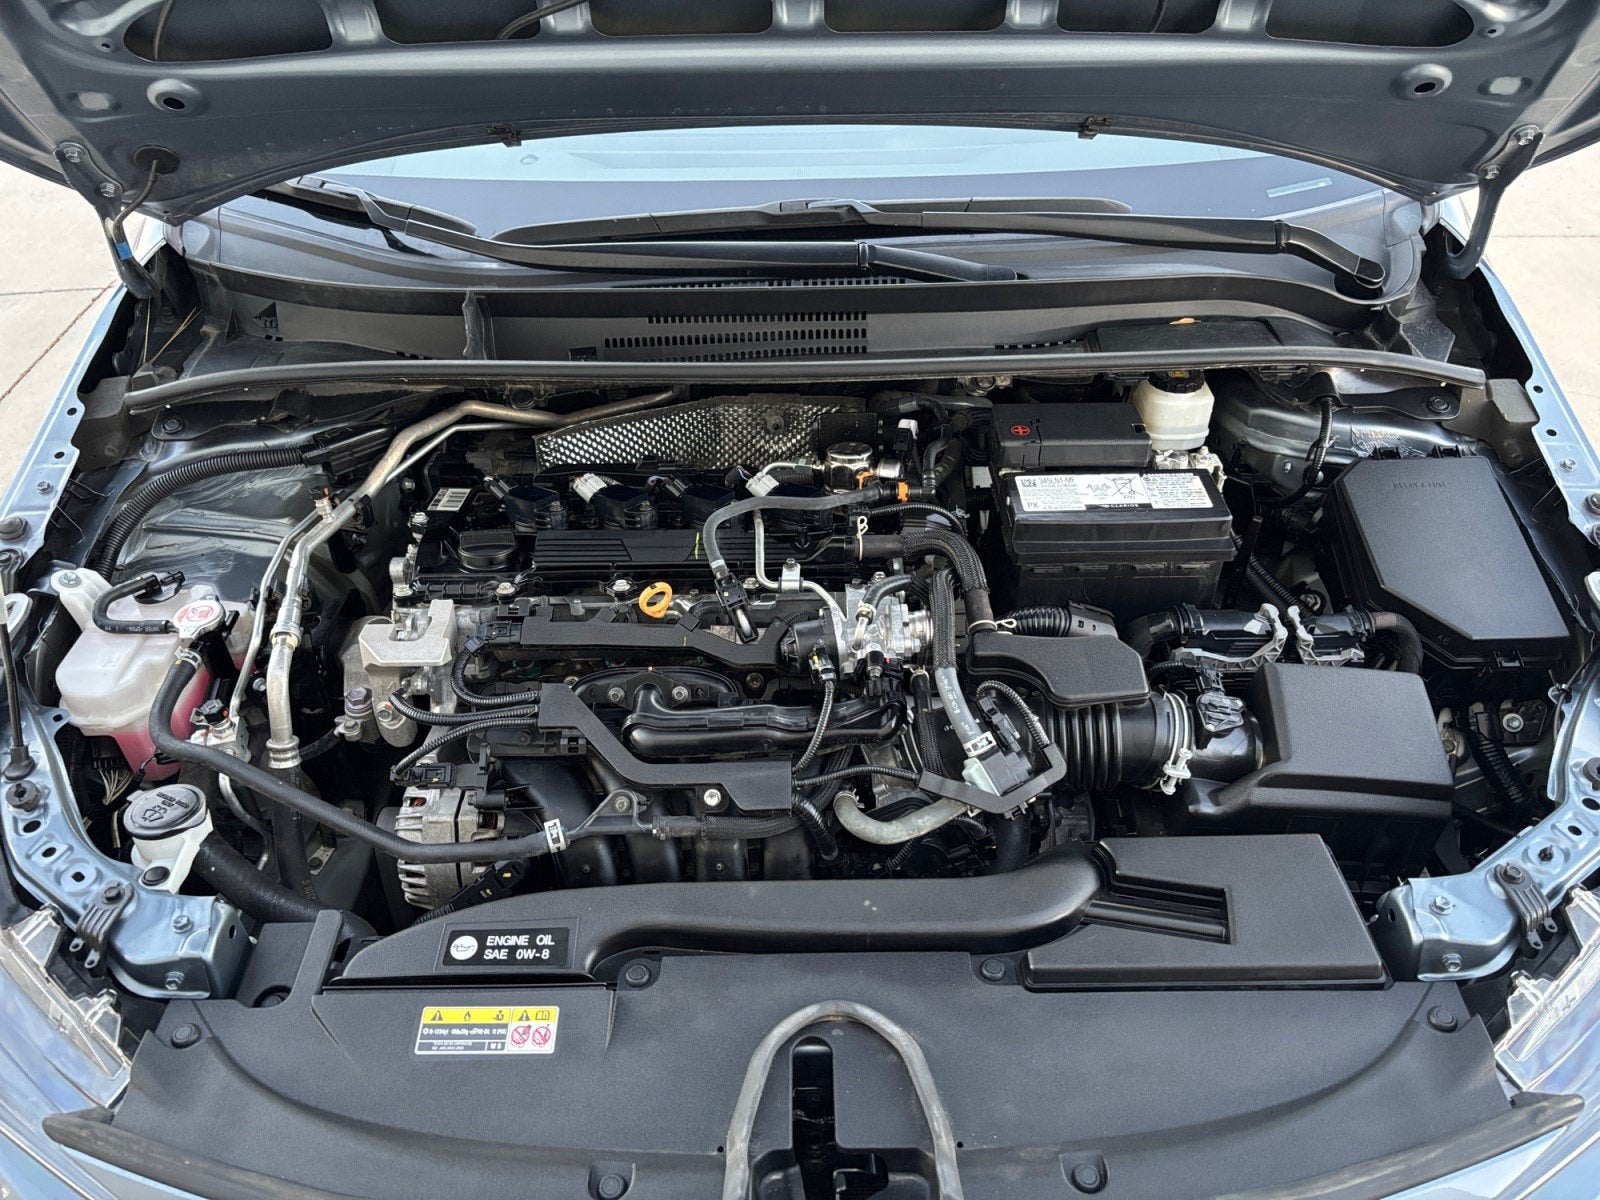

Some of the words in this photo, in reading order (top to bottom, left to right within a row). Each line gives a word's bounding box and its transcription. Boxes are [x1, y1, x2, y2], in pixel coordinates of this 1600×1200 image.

[486, 934, 530, 946] ENGINE
[535, 934, 556, 946] OIL
[483, 948, 509, 960] SAE
[515, 948, 550, 960] 0W-8
